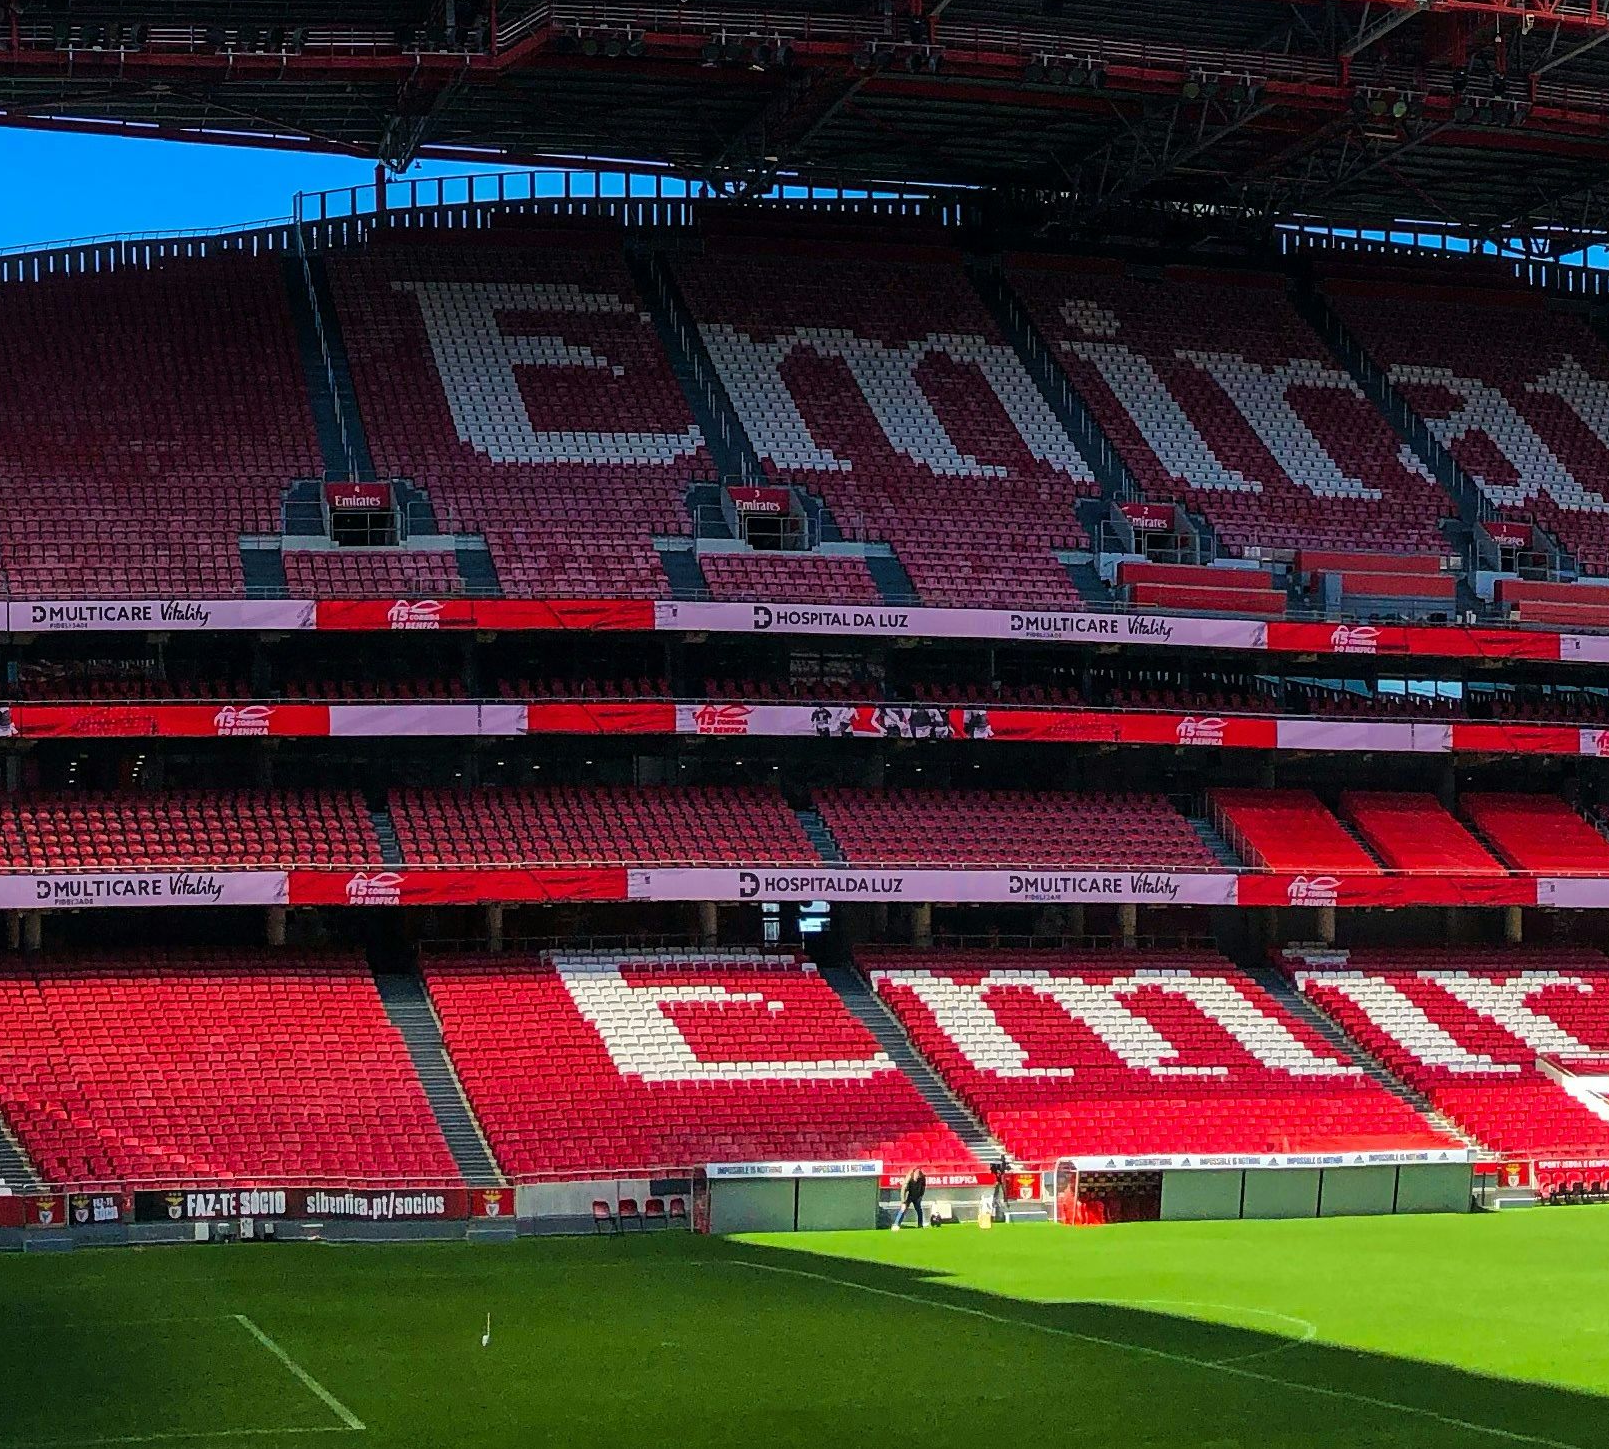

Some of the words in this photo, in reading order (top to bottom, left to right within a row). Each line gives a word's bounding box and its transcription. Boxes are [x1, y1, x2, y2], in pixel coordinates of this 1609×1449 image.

[354, 485, 359, 494] 4
[755, 489, 760, 498] 3
[335, 494, 381, 507] Emirates
[736, 499, 781, 512] Emirates
[1143, 506, 1149, 515] 2
[50, 606, 152, 621] MULTICARE
[160, 601, 211, 626] Vitality
[777, 611, 851, 626] HOSPITAL
[854, 613, 875, 626] DA
[880, 615, 908, 627] LUZ
[1026, 617, 1119, 633] MULTICARE
[1127, 614, 1173, 640] Vitality
[55, 880, 162, 897] MULTICARE
[169, 873, 224, 901] Vitality
[765, 878, 845, 892] HOSPITAL
[845, 878, 869, 892] DA
[872, 878, 902, 892] LUZ
[1024, 876, 1122, 893] MULTICARE
[1130, 870, 1180, 900] Vitality
[188, 1193, 236, 1216] FAZ-TE
[240, 1189, 286, 1215] SÓCIO
